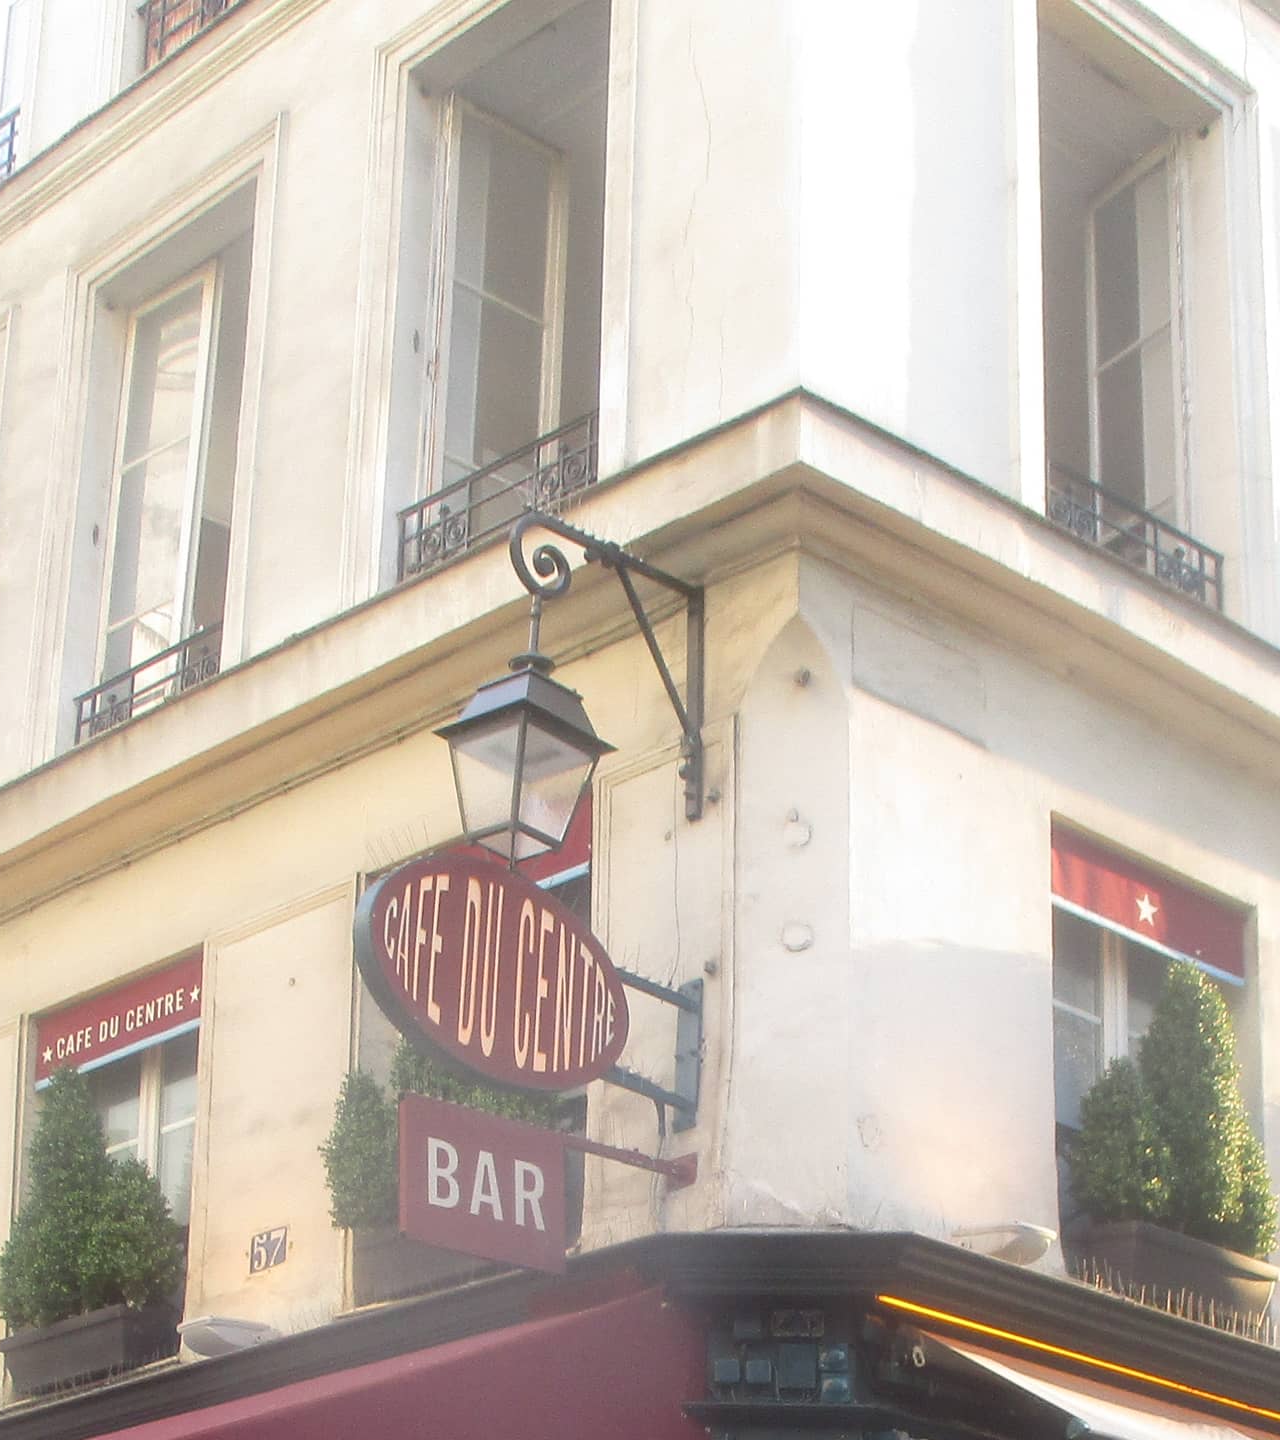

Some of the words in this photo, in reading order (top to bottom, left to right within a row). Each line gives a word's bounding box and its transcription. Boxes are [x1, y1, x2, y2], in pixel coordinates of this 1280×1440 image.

[384, 873, 450, 1025] CAFE
[457, 876, 505, 1057] DU
[514, 896, 618, 1073] CENTRE
[55, 1024, 93, 1060] CAFE
[99, 1015, 120, 1045] DU
[125, 988, 185, 1032] CENTRE
[426, 1137, 546, 1232] BAR
[252, 1228, 287, 1273] 57
